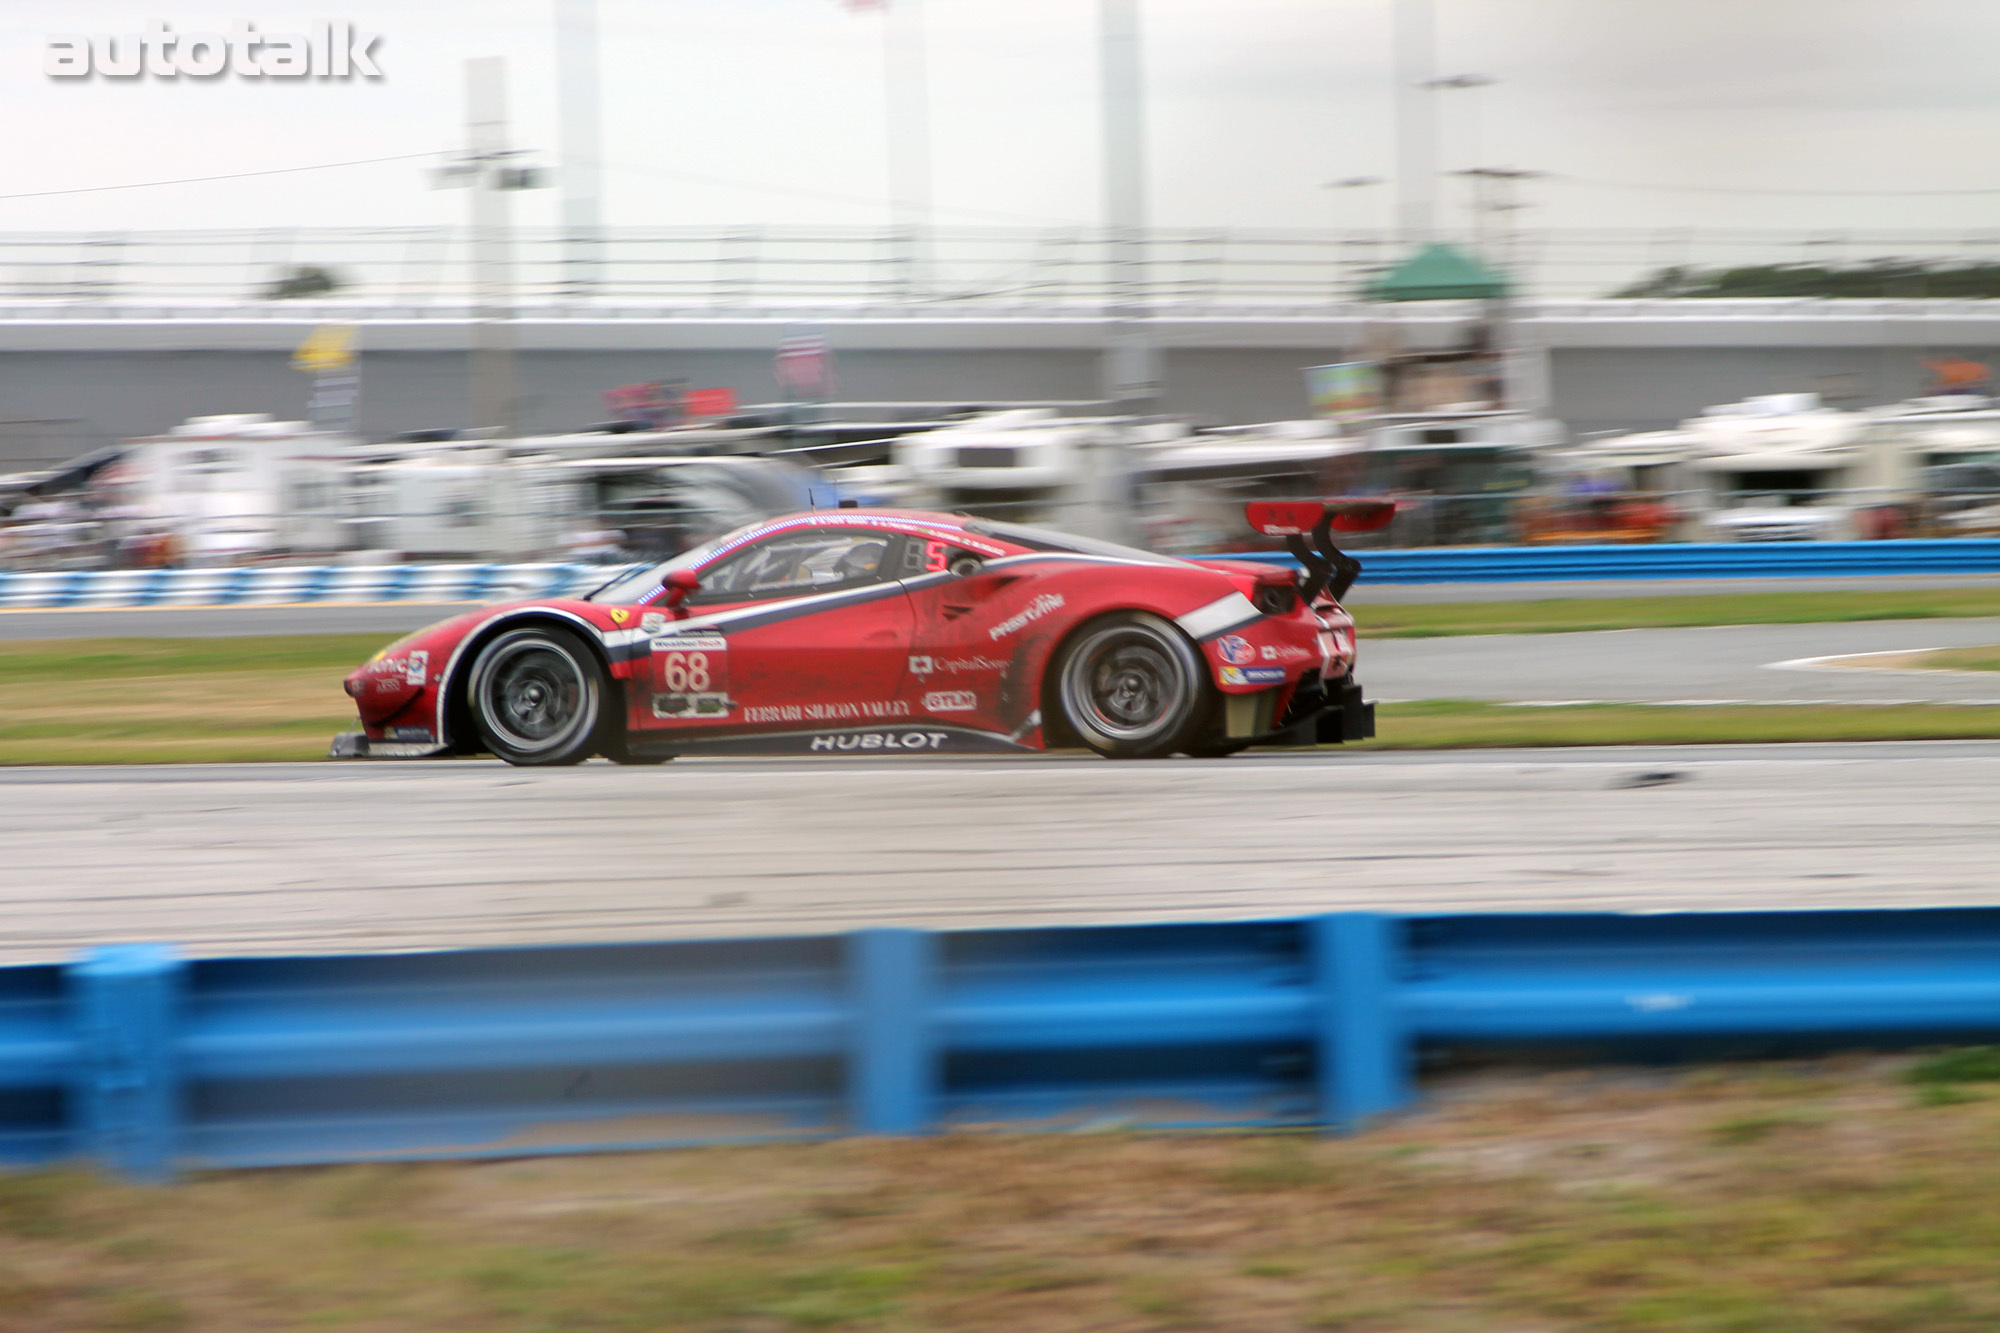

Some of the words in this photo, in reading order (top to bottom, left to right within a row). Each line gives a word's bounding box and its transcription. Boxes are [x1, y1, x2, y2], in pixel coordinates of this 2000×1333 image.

[925, 540, 947, 571] 5
[664, 651, 711, 693] 68
[744, 704, 802, 723] FERRARI
[811, 732, 948, 751] HUBLOT
